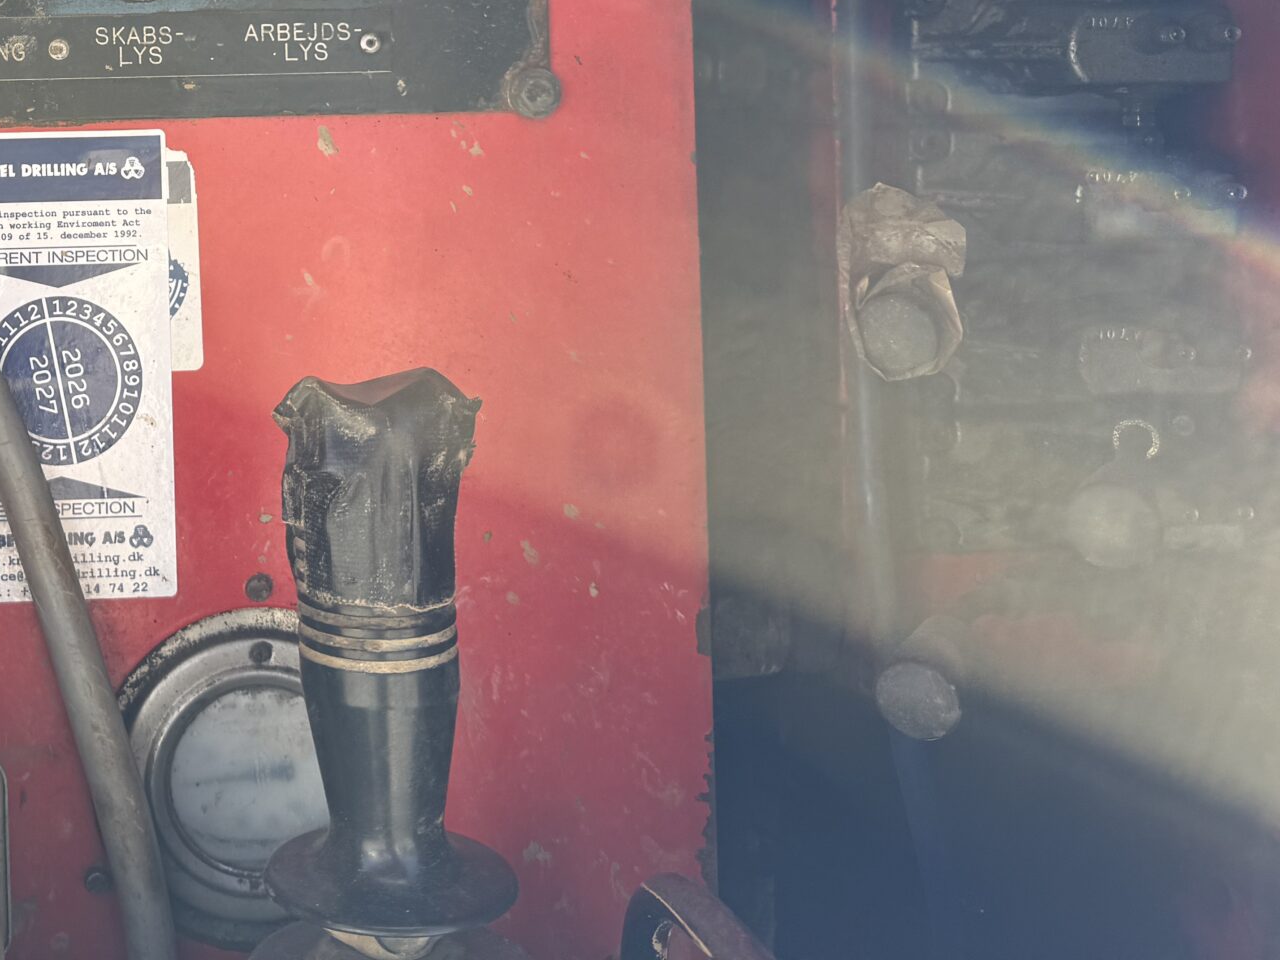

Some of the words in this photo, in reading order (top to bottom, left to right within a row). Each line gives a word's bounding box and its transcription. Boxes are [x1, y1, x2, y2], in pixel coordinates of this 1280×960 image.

[95, 26, 184, 45] SKABS-
[244, 22, 362, 42] ARBEJDS-
[120, 46, 163, 67] LYS
[285, 42, 328, 61] LYS
[21, 162, 87, 177] DRILLING
[94, 162, 117, 175] A/S
[63, 209, 110, 218] pursuant
[117, 208, 128, 216] to
[134, 207, 152, 216] the
[9, 221, 51, 230] working
[57, 220, 117, 228] Enviroment
[122, 219, 141, 227] Act
[18, 233, 30, 241] of
[36, 232, 53, 240] 15.
[60, 231, 108, 239] december
[114, 230, 142, 238] 1992.
[48, 249, 149, 265] INSPECTION
[30, 355, 58, 414] 2027
[62, 348, 90, 409] 2026
[102, 531, 125, 544] A/S
[85, 584, 100, 594] 14
[109, 583, 123, 593] 74
[133, 582, 148, 592] 22
